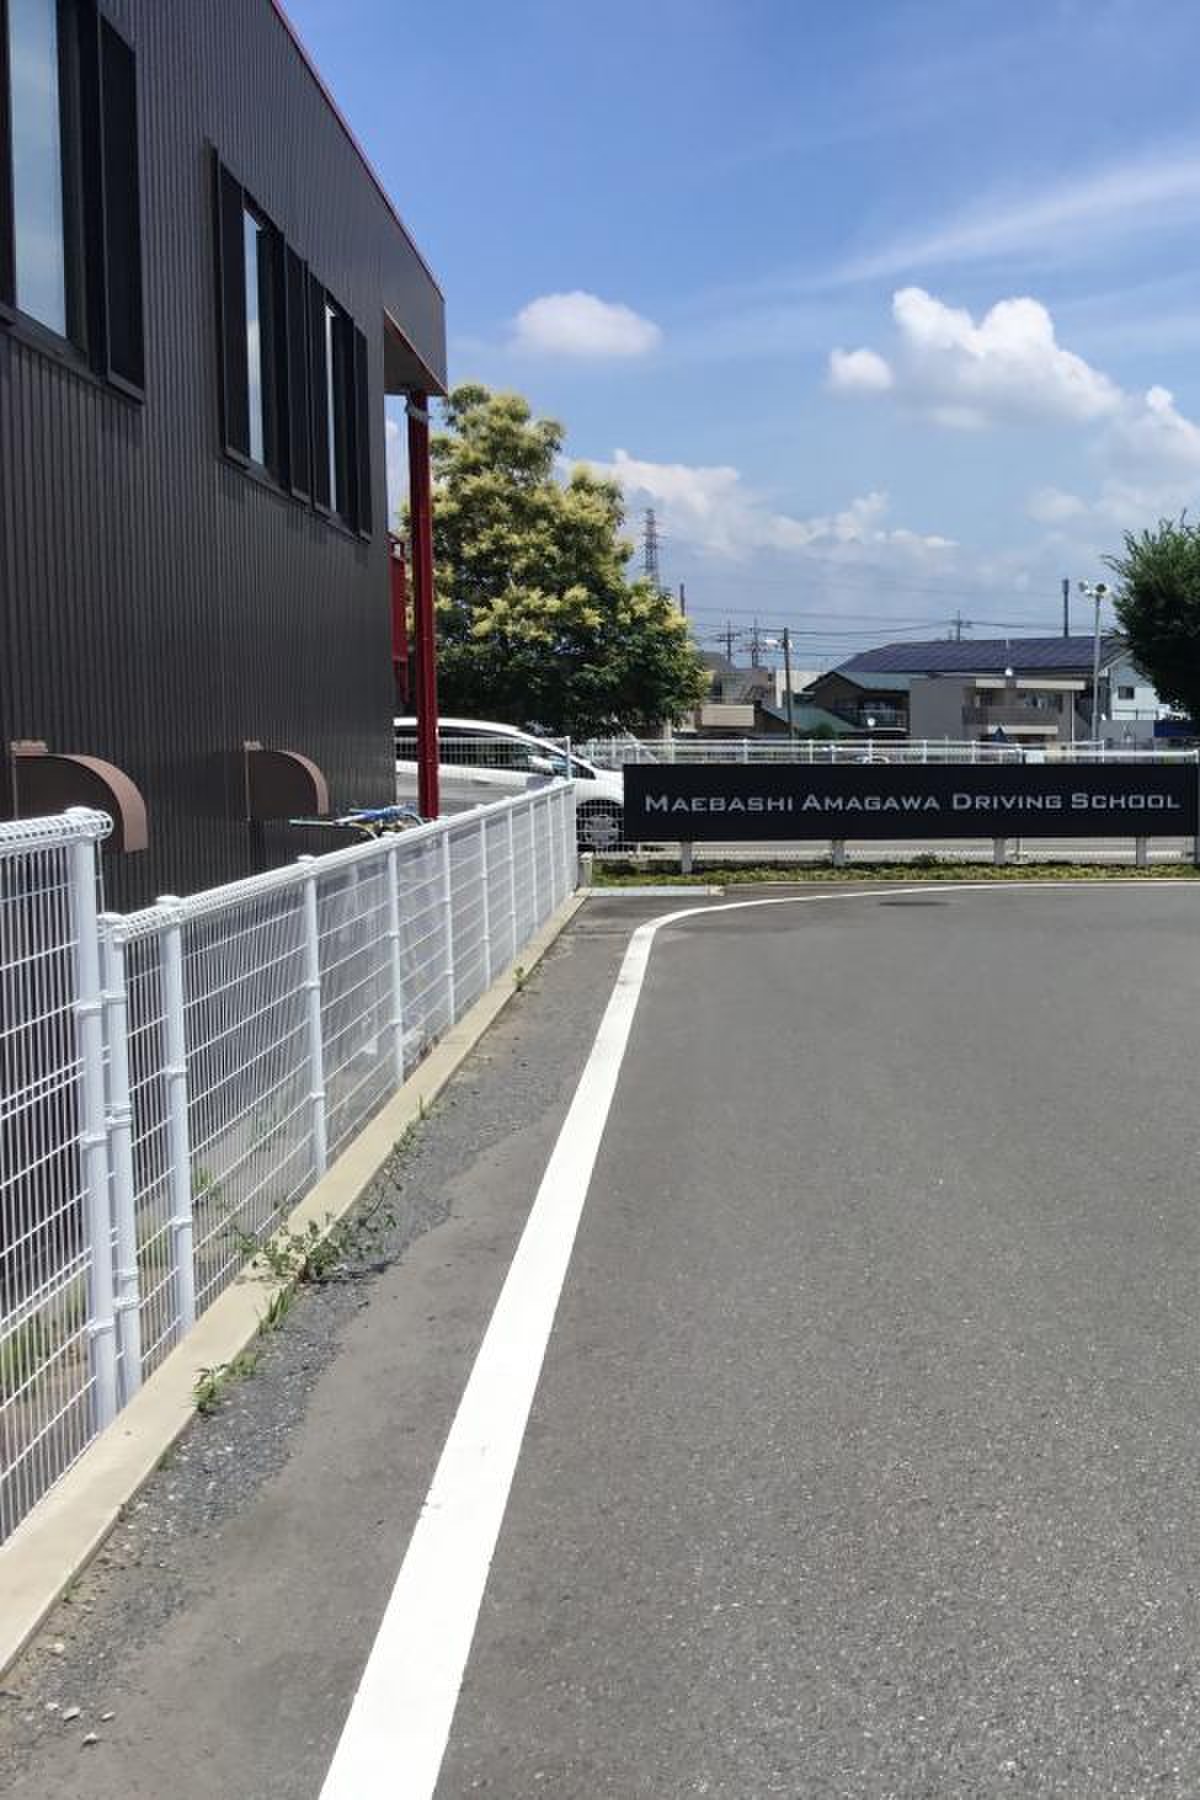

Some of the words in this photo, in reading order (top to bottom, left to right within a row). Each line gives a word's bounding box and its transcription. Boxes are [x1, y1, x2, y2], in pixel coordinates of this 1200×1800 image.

[645, 795, 793, 812] MAEBASHI
[801, 794, 940, 811] AMAGAWA
[952, 793, 1062, 810] DRIVING
[1071, 792, 1180, 809] SCHOOL
